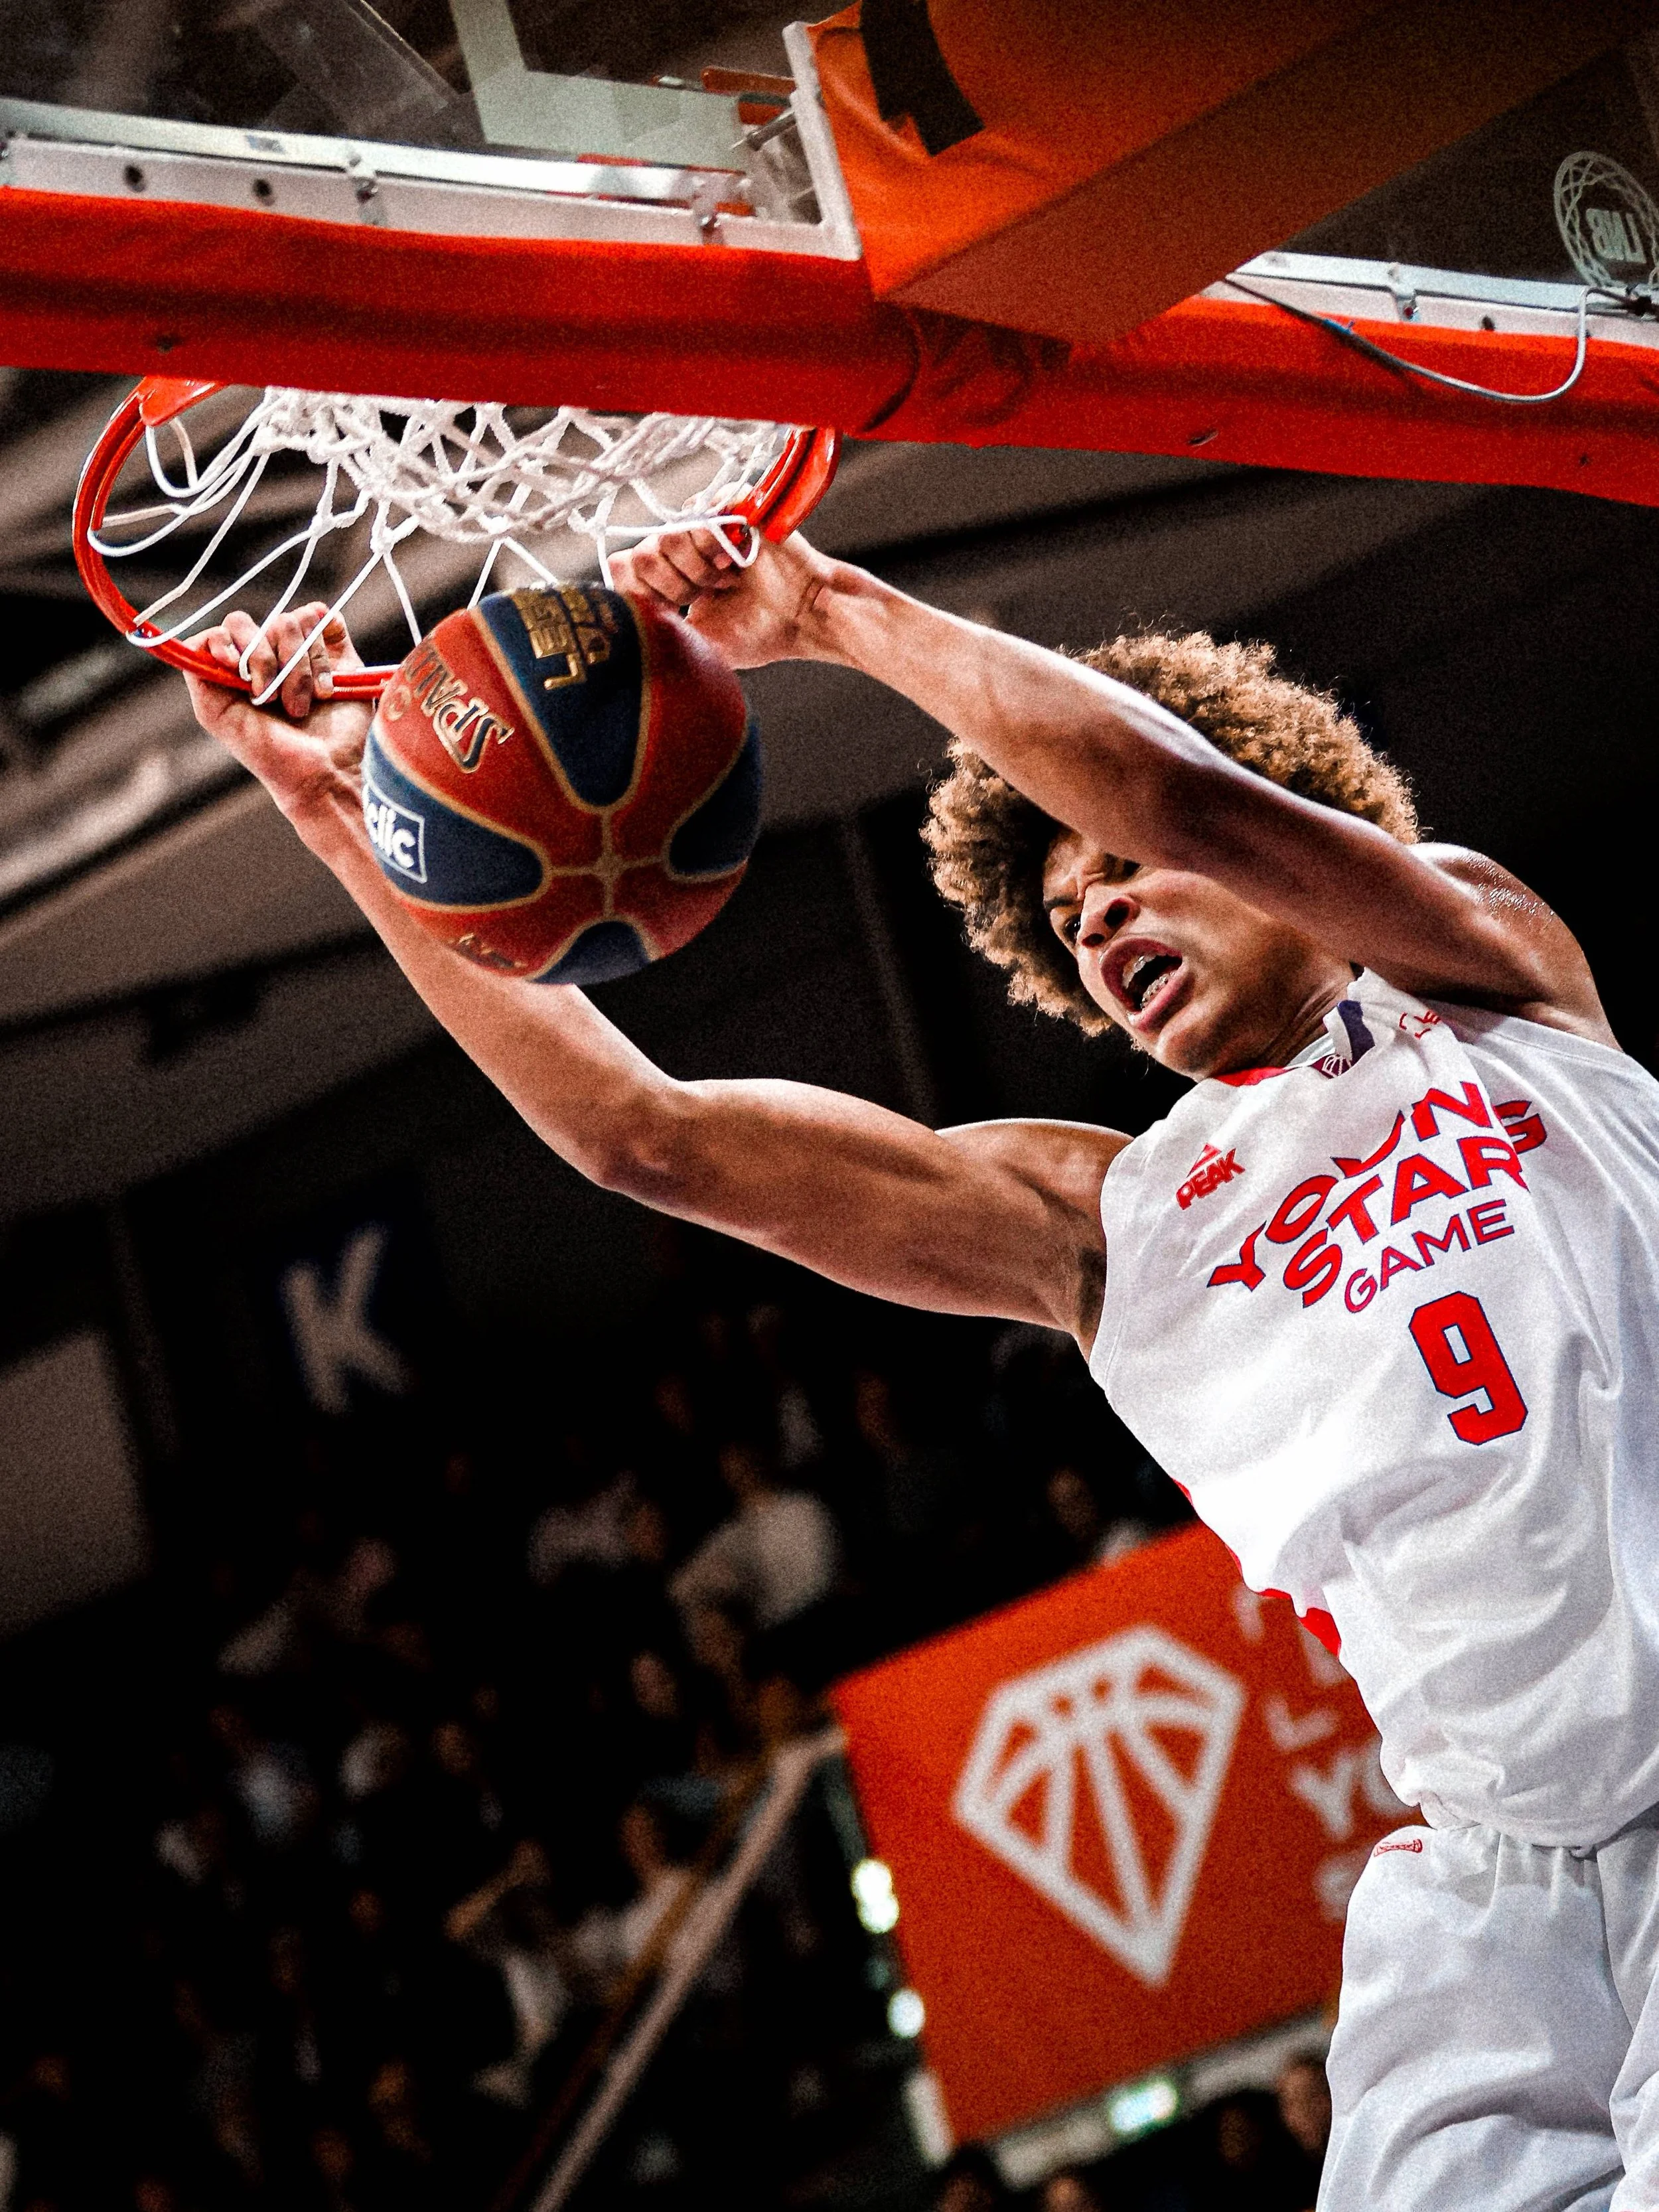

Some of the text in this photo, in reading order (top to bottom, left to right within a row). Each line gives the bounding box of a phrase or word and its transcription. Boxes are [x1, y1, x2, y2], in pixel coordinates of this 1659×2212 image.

[1175, 1147, 1246, 1211] PEAK
[1344, 1199, 1515, 1314] GAME
[1408, 1291, 1529, 1445] 9
